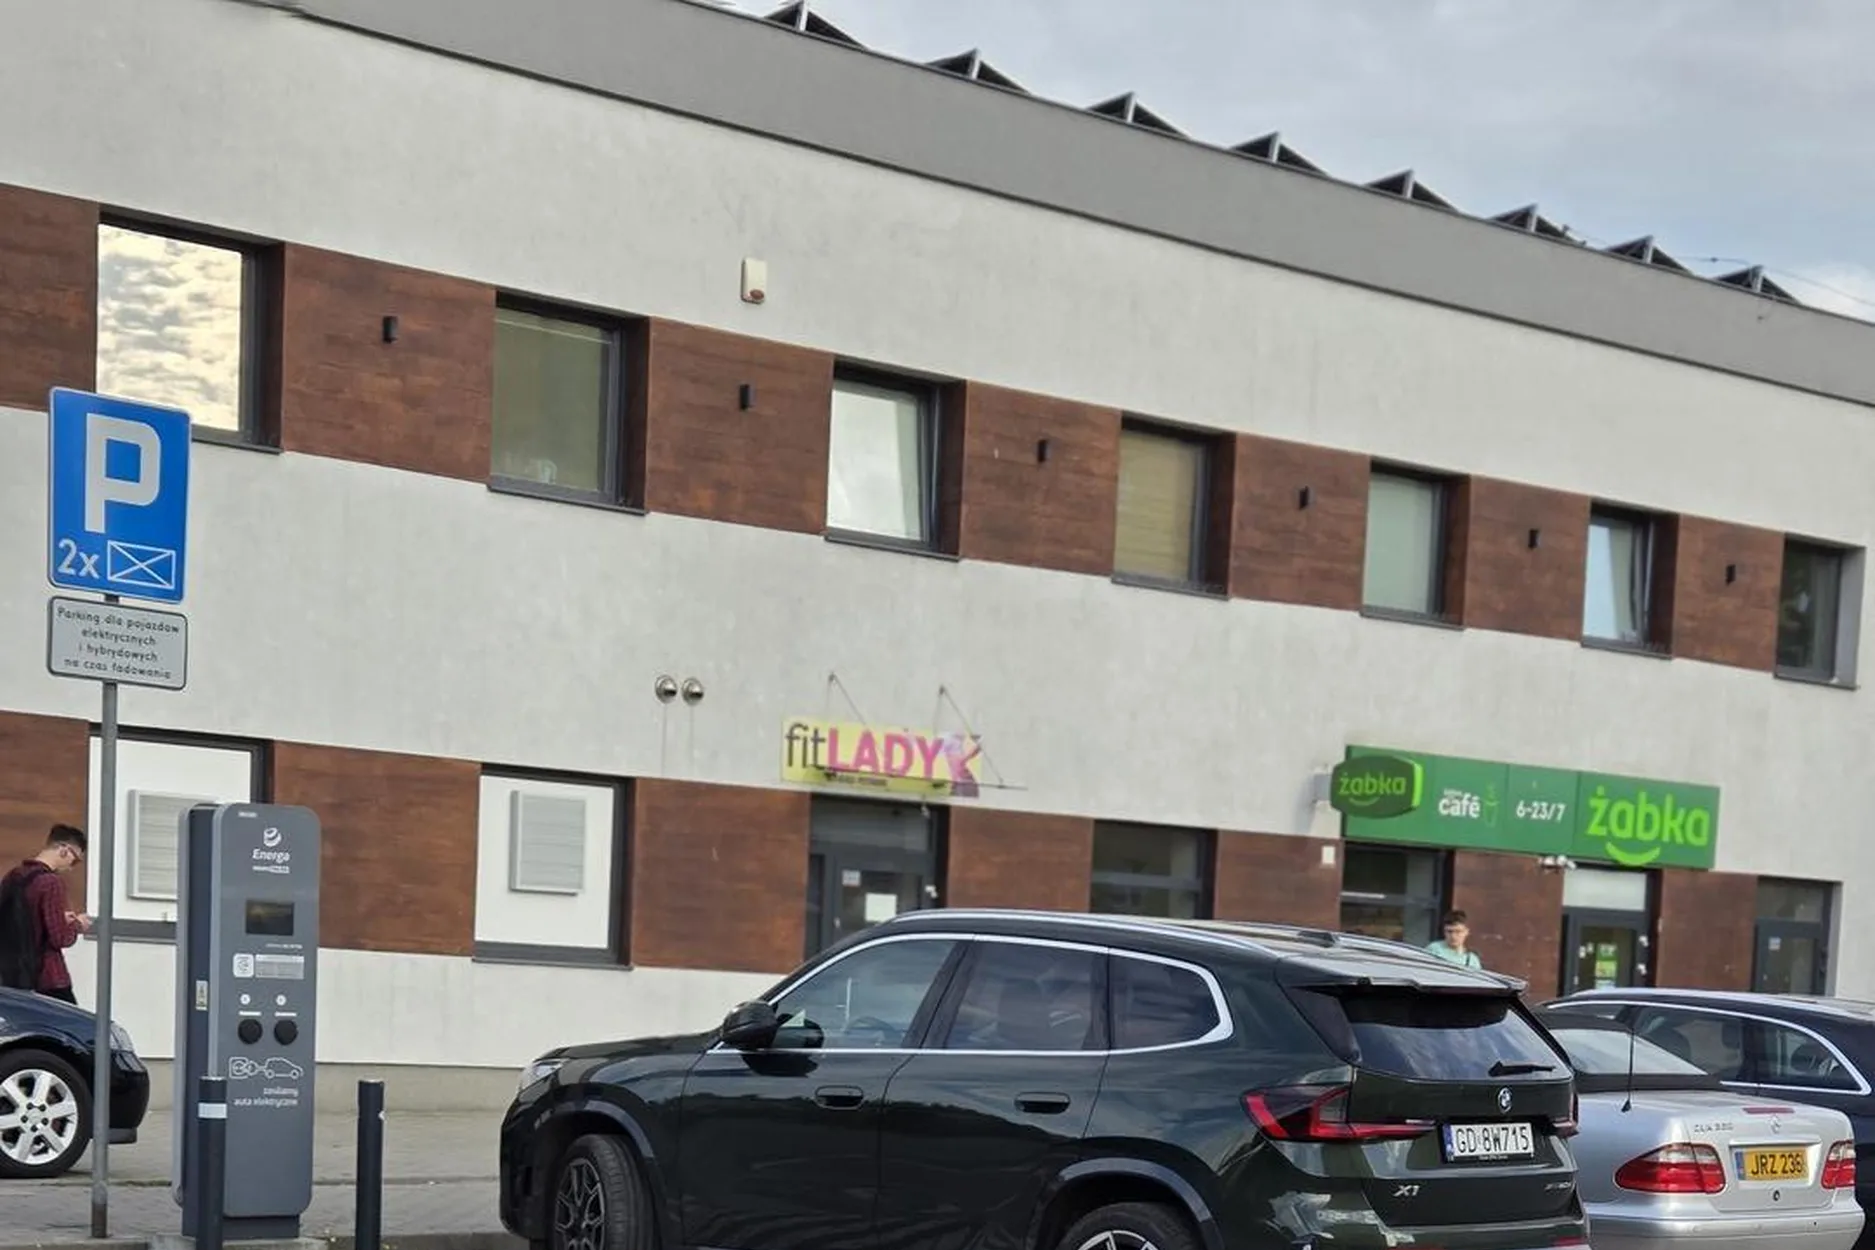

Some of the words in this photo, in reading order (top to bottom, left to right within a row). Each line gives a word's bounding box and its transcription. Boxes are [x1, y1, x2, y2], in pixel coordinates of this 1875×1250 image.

[84, 413, 161, 533] P
[57, 538, 100, 579] 2x
[57, 606, 100, 625] Parking
[104, 614, 122, 626] dla
[81, 627, 156, 645] elektrycznych
[86, 644, 158, 662] hybrydowych
[63, 659, 79, 668] na
[84, 660, 108, 672] czas
[1338, 772, 1408, 797] żabka
[1516, 800, 1567, 822] 6-23/7
[1587, 785, 1710, 847] żabka
[252, 848, 290, 864] Energa
[1455, 1127, 1476, 1153] GD
[1482, 1126, 1530, 1152] 8W715
[1751, 1153, 1778, 1176] JRZ
[1394, 1185, 1420, 1196] X1
